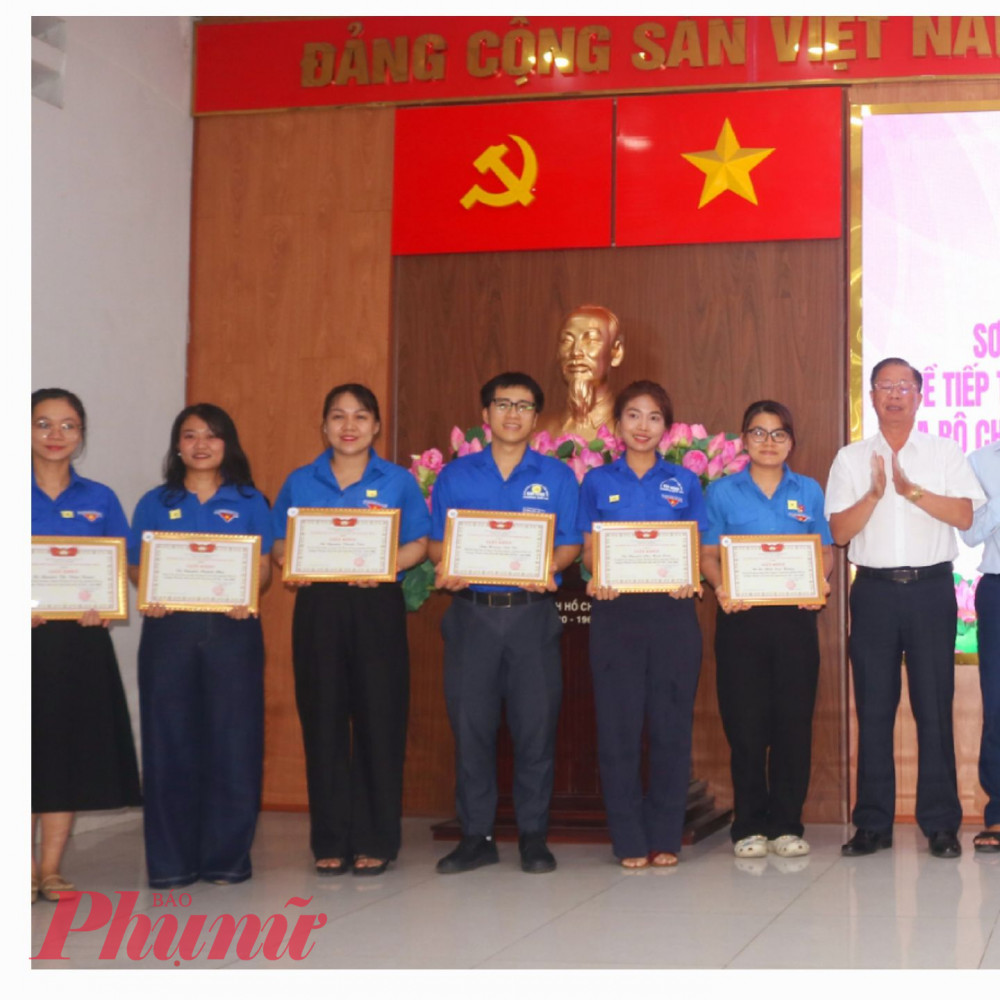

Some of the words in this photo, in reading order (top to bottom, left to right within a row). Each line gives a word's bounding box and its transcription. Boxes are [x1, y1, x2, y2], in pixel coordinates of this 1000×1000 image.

[301, 21, 447, 88] ĐẢNG
[466, 16, 611, 86] CỘNG
[923, 363, 938, 407] Ề
[942, 362, 990, 407] TIẾP
